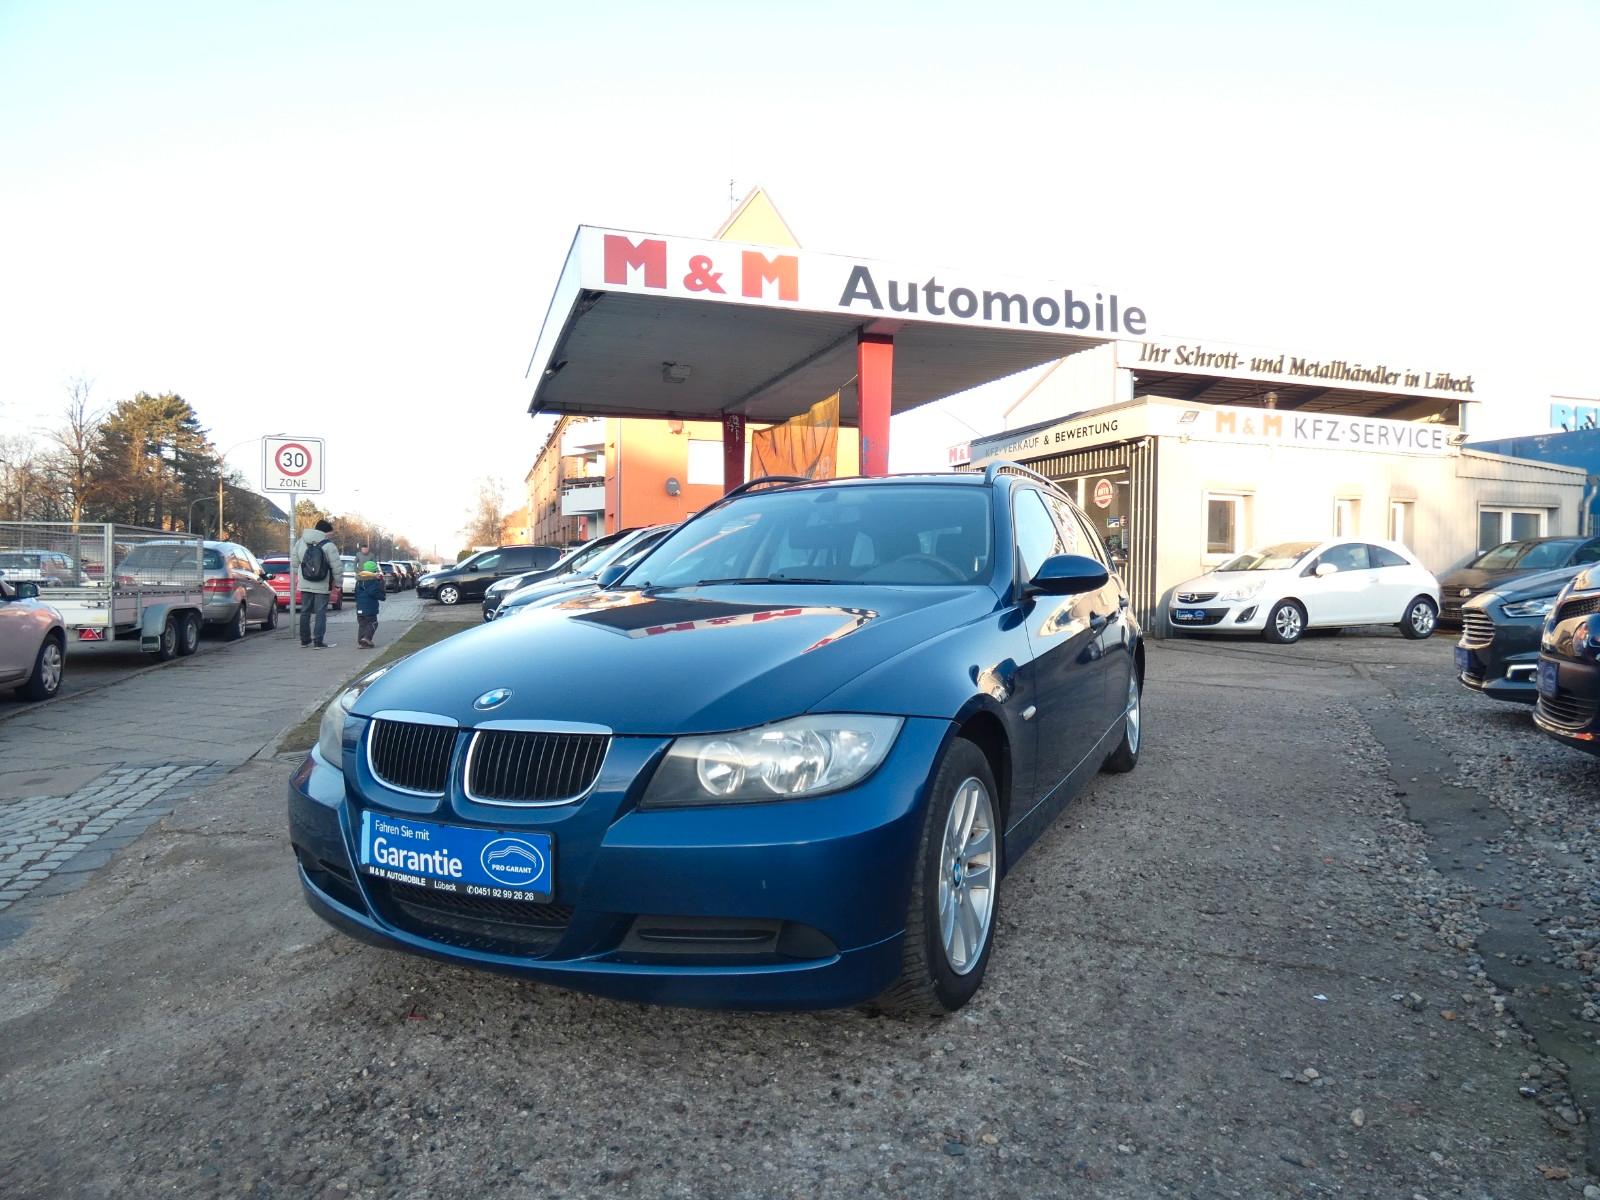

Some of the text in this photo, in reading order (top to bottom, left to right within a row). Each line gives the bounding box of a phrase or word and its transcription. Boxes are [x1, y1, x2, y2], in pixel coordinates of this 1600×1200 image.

[604, 234, 1147, 335] M & M Automobile
[1139, 343, 1475, 393] Ihr Schrott- und Metallhändler in Lübeck
[1043, 436, 1050, 446] &
[1055, 420, 1119, 443] BEWERTUNG
[1216, 411, 1236, 435] M
[1243, 418, 1256, 435] &
[1263, 415, 1283, 437] M
[283, 452, 304, 468] 30
[279, 478, 308, 488] ZONE
[375, 820, 430, 841] Fahren Sie mit
[374, 837, 463, 878] Garantie
[506, 865, 532, 874] GARANT
[387, 870, 426, 886] AUTOMOBILE
[434, 880, 457, 892] Lübeck
[474, 886, 491, 896] 0451
[493, 888, 502, 898] 92
[514, 891, 523, 900] 26
[525, 892, 534, 901] 26
